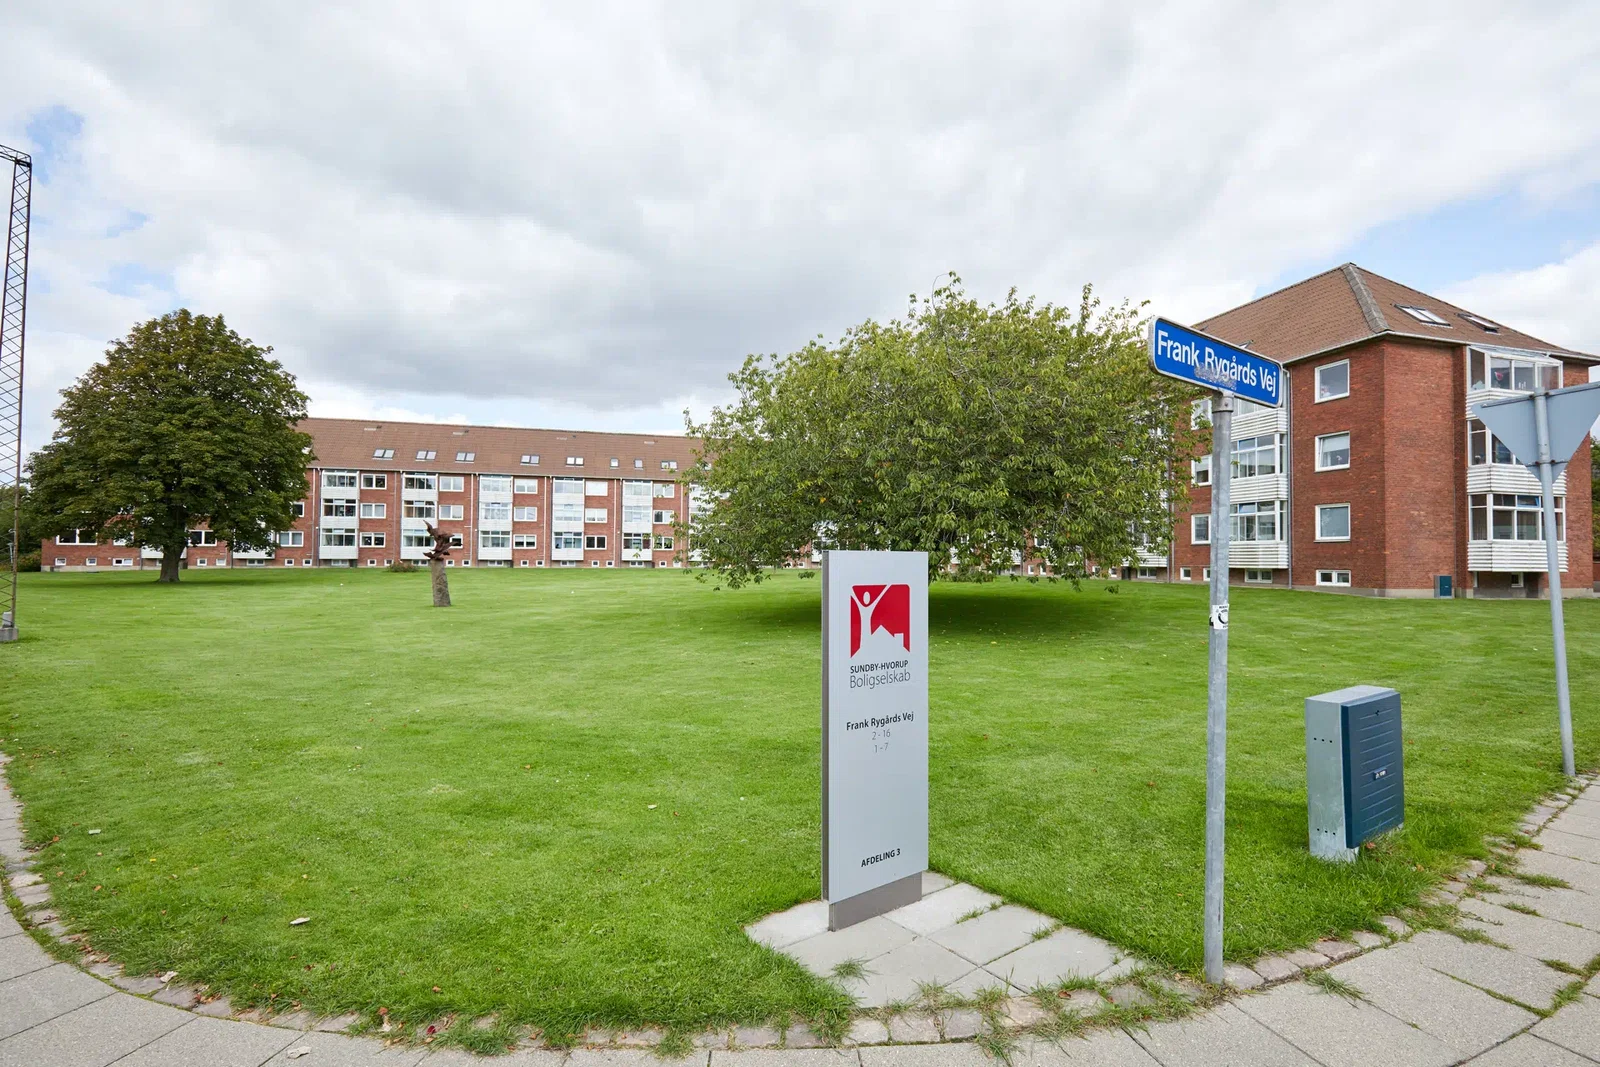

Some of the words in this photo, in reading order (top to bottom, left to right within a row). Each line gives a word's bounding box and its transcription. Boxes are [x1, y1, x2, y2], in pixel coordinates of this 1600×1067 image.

[1157, 329, 1200, 367] Frank
[1204, 346, 1257, 386] Rygårds
[1259, 366, 1277, 397] Vej
[850, 660, 908, 674] SUNDBY-HVORUP
[849, 669, 911, 689] Boligselskab
[846, 718, 869, 731] Frank
[870, 713, 901, 728] Rygårds
[902, 711, 914, 722] Vej
[860, 850, 896, 868] AFDELING
[896, 848, 901, 856] 3
